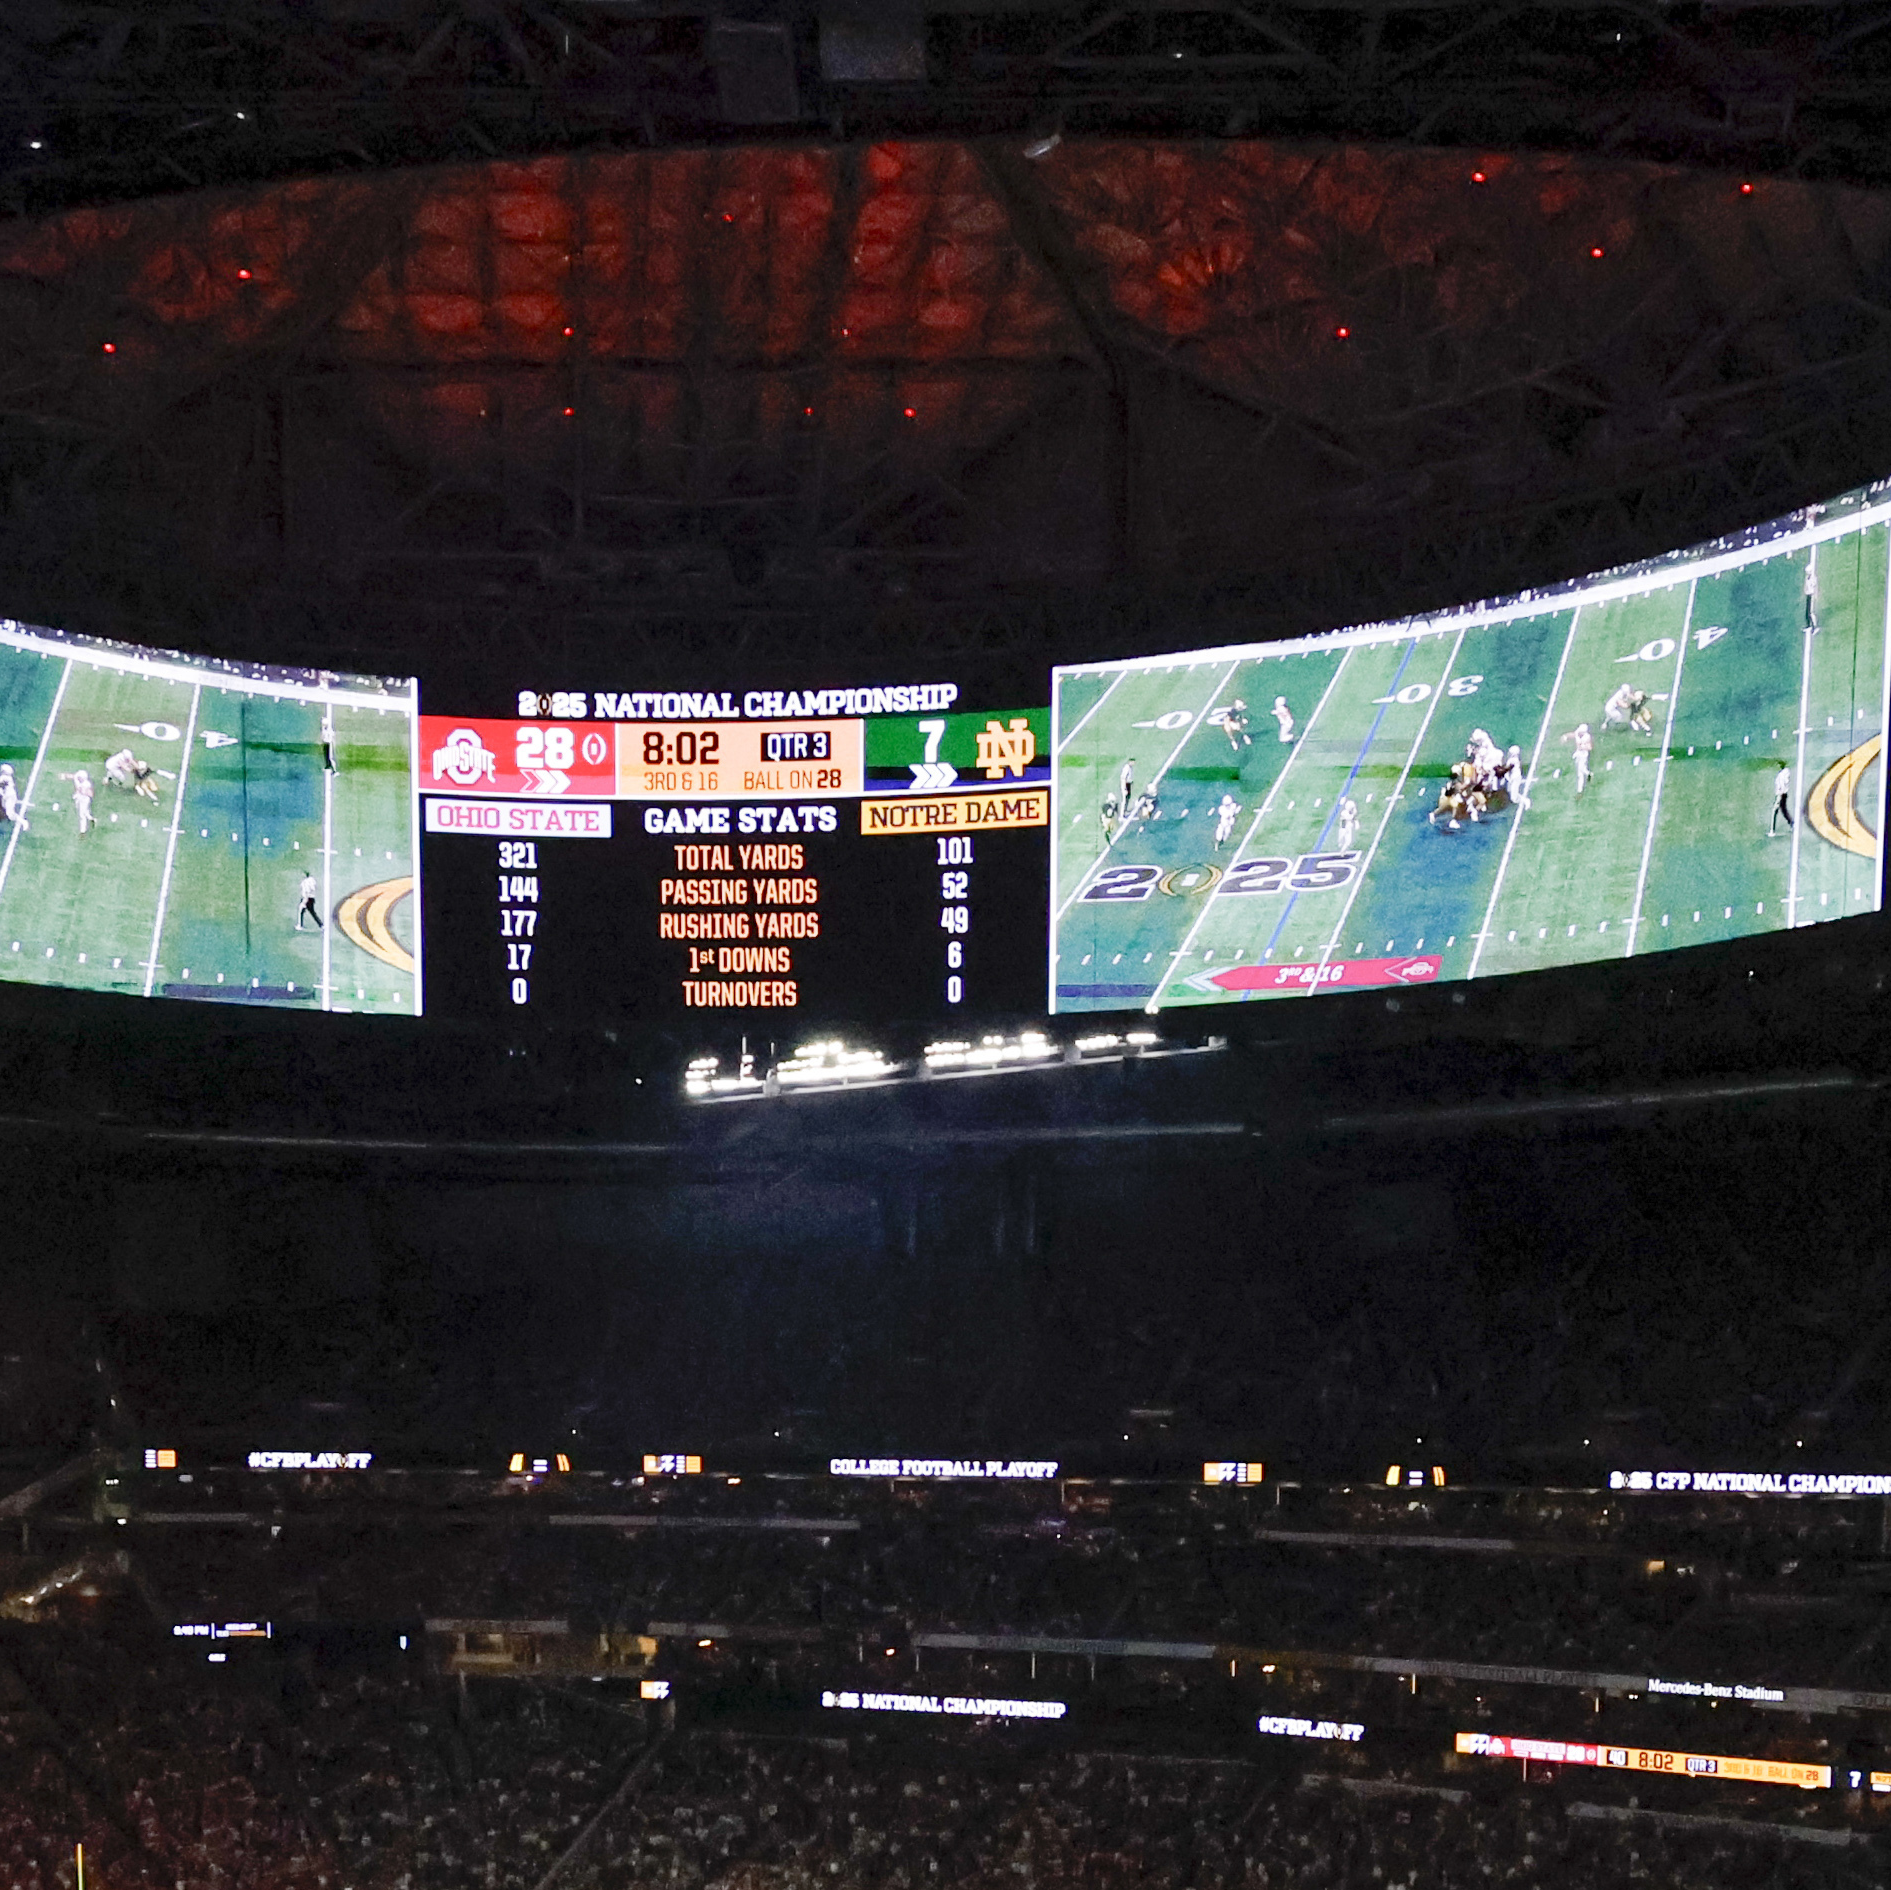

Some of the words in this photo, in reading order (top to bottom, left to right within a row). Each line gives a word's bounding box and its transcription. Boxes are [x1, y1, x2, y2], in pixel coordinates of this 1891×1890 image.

[594, 692, 740, 719] NATIONAL
[744, 683, 958, 717] CHAMPIONSHIP
[516, 726, 575, 769] 28
[643, 731, 720, 765] 8:02
[766, 733, 808, 761] QTR
[813, 732, 827, 757] 3
[918, 719, 946, 764] 7
[643, 771, 676, 791] 3RD
[699, 771, 719, 791] 16
[743, 770, 784, 791] BALL
[790, 769, 812, 789] ON
[817, 768, 842, 789] 28
[437, 805, 500, 829] OHIO
[509, 808, 600, 832] STATE
[643, 807, 730, 834] GAME
[738, 805, 838, 833] STATS
[869, 804, 957, 829] NOTRE
[965, 798, 1040, 823] DAME
[498, 842, 537, 870] 321
[674, 845, 733, 871] TOTAL
[739, 844, 804, 870] YARDS
[937, 837, 973, 865] 101
[498, 875, 539, 903] 144
[660, 879, 748, 905] PASSING
[753, 878, 818, 904] YARDS
[942, 872, 968, 899] 52
[500, 910, 537, 937] 177
[660, 912, 749, 939] RUSHING
[754, 912, 819, 939] YARDS
[941, 907, 968, 934] 49
[506, 943, 532, 971] 17
[719, 946, 791, 973] DOWNS
[947, 941, 962, 968] 6
[511, 977, 528, 1004] 0
[682, 980, 797, 1007] TURNOVERS
[830, 1459, 900, 1475] COLLEGE
[902, 1460, 985, 1476] FOOTBALL
[986, 1461, 1058, 1478] PLAYOFF
[1656, 1472, 1691, 1490] CFP
[1693, 1473, 1787, 1493] NATIONAL
[1648, 1678, 1732, 1698] Mercedes-Benz
[1734, 1685, 1784, 1701] Stadium
[862, 1693, 942, 1712] NATIONAL
[943, 1697, 1066, 1718] CHAMPIONSHIP
[1639, 1752, 1673, 1770] 8:02
[1687, 1758, 1707, 1772] QTR
[1850, 1771, 1861, 1788] 7
